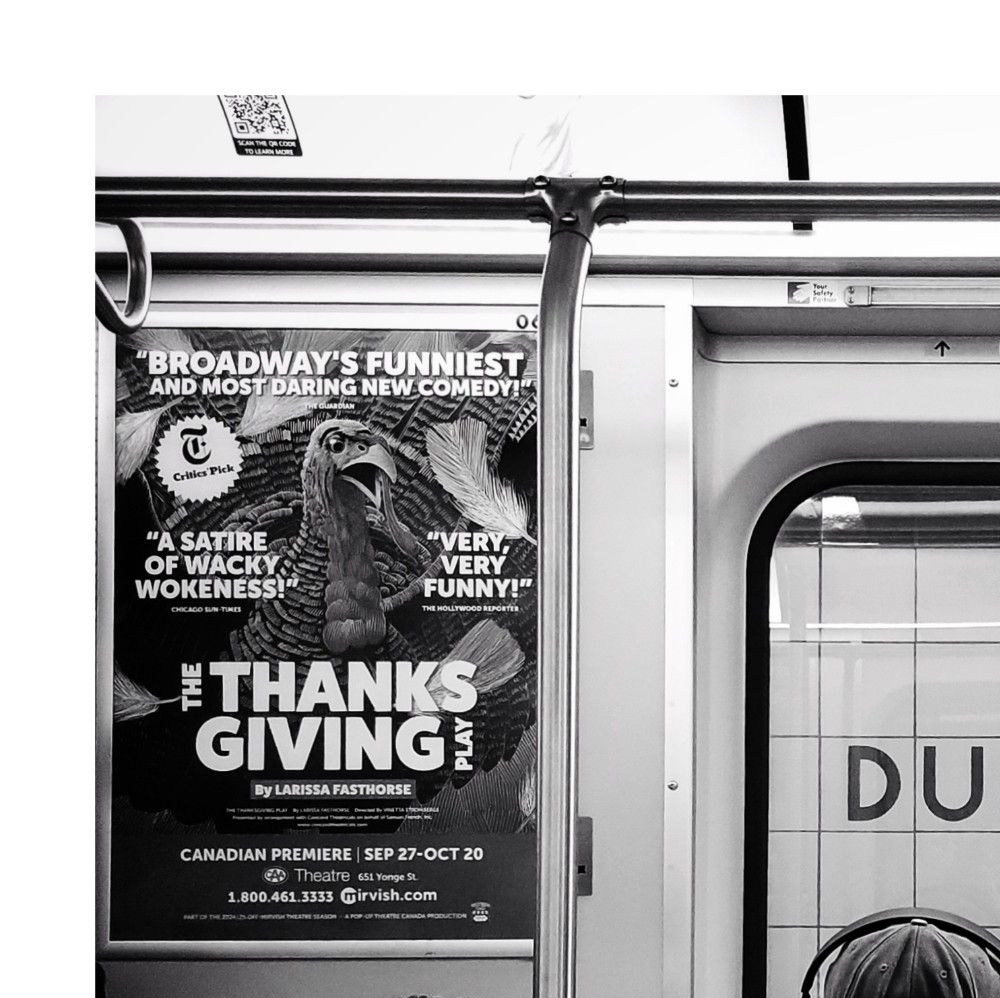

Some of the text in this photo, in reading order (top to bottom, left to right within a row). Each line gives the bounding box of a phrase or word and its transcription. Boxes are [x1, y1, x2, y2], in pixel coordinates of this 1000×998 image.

[268, 140, 278, 148] QR
[279, 140, 297, 148] CODE
[366, 351, 525, 377] FUNNIEST
[149, 377, 197, 396] AND
[201, 378, 268, 396] MOST
[271, 378, 357, 397] DARING
[361, 379, 414, 397] NEW
[209, 464, 235, 476] Pick
[180, 531, 268, 552] SATIRE
[144, 555, 281, 576] OF WACKY
[440, 555, 507, 575] VERY
[181, 662, 202, 712] THE
[209, 660, 478, 713] THANKS
[195, 715, 445, 772] GIVING
[454, 716, 474, 771] PLAY
[254, 784, 412, 797] By LARISSA FASTHORSE
[180, 847, 484, 862] CANADIAN PREMIERE SEP 27-OCT 20
[294, 868, 351, 882] Theatre
[358, 872, 375, 882] 651
[376, 872, 405, 883] Yonge
[406, 872, 419, 882] St.
[228, 891, 334, 903] 1.800.461.3333
